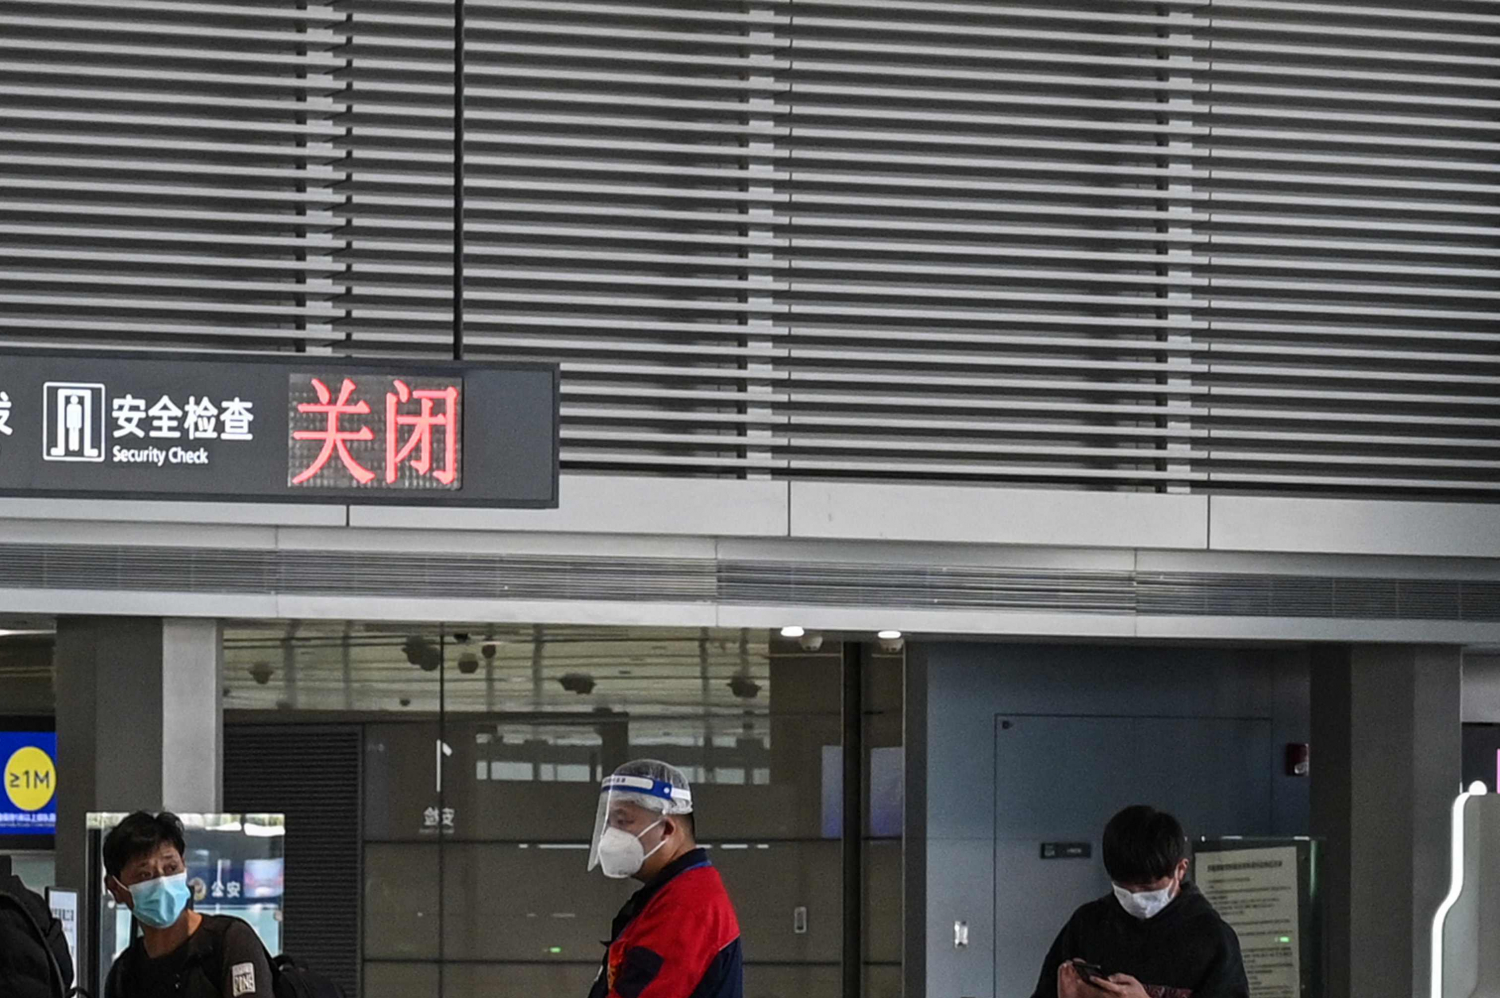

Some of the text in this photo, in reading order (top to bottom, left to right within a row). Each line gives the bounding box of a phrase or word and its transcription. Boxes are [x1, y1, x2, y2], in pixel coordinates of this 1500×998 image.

[111, 394, 255, 441] 安全检查
[292, 379, 459, 487] 关闭
[112, 444, 208, 468] Security Check
